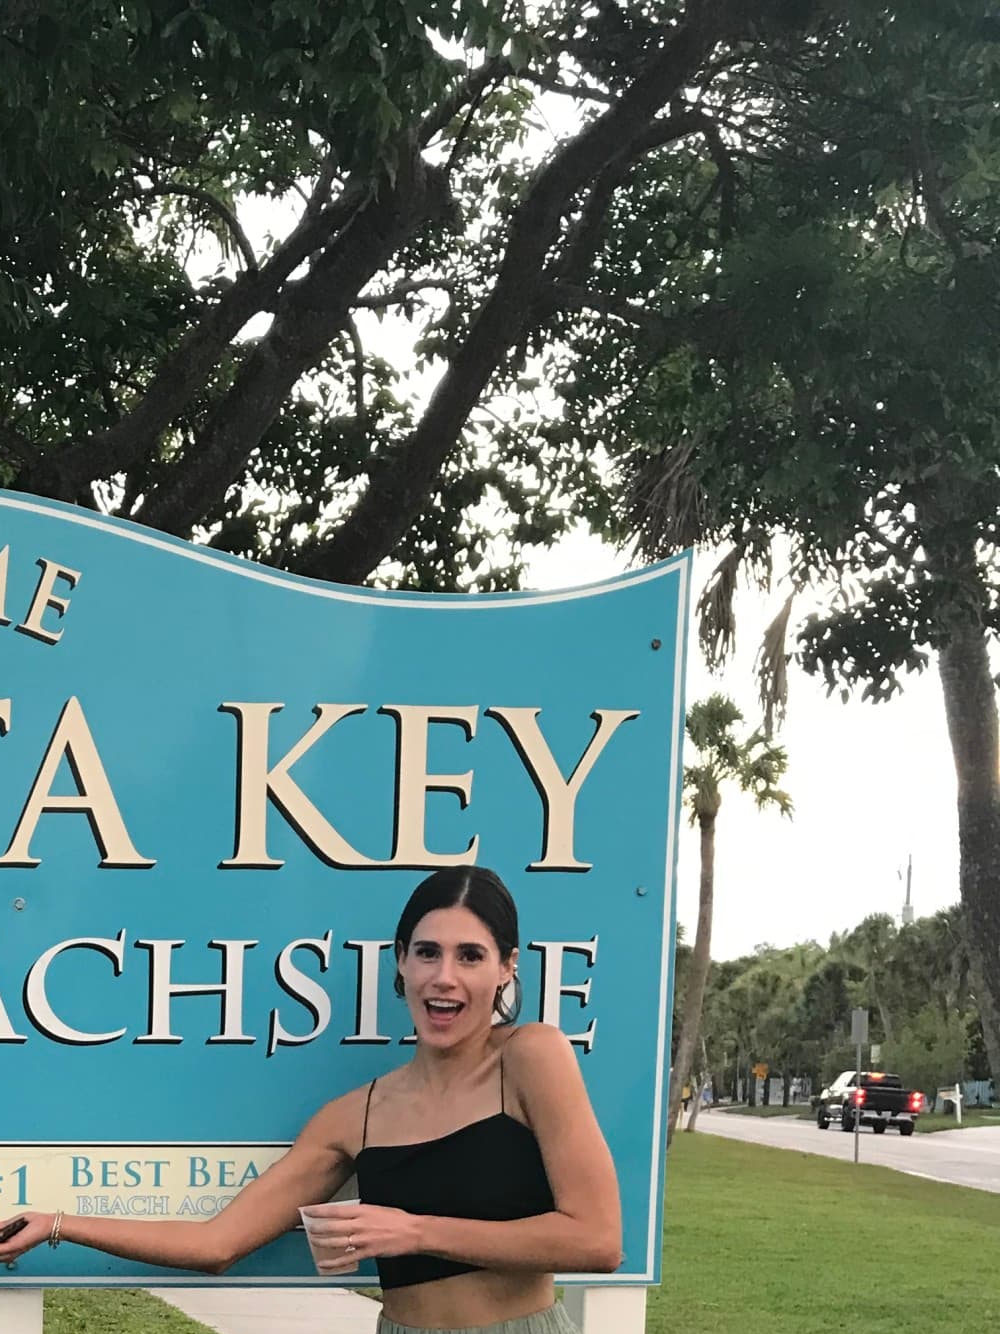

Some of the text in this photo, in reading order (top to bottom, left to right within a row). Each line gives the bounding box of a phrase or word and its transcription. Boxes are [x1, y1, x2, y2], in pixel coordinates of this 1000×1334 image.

[217, 701, 641, 872] KEY
[69, 1155, 171, 1188] BEST
[76, 1195, 170, 1216] BEACH
